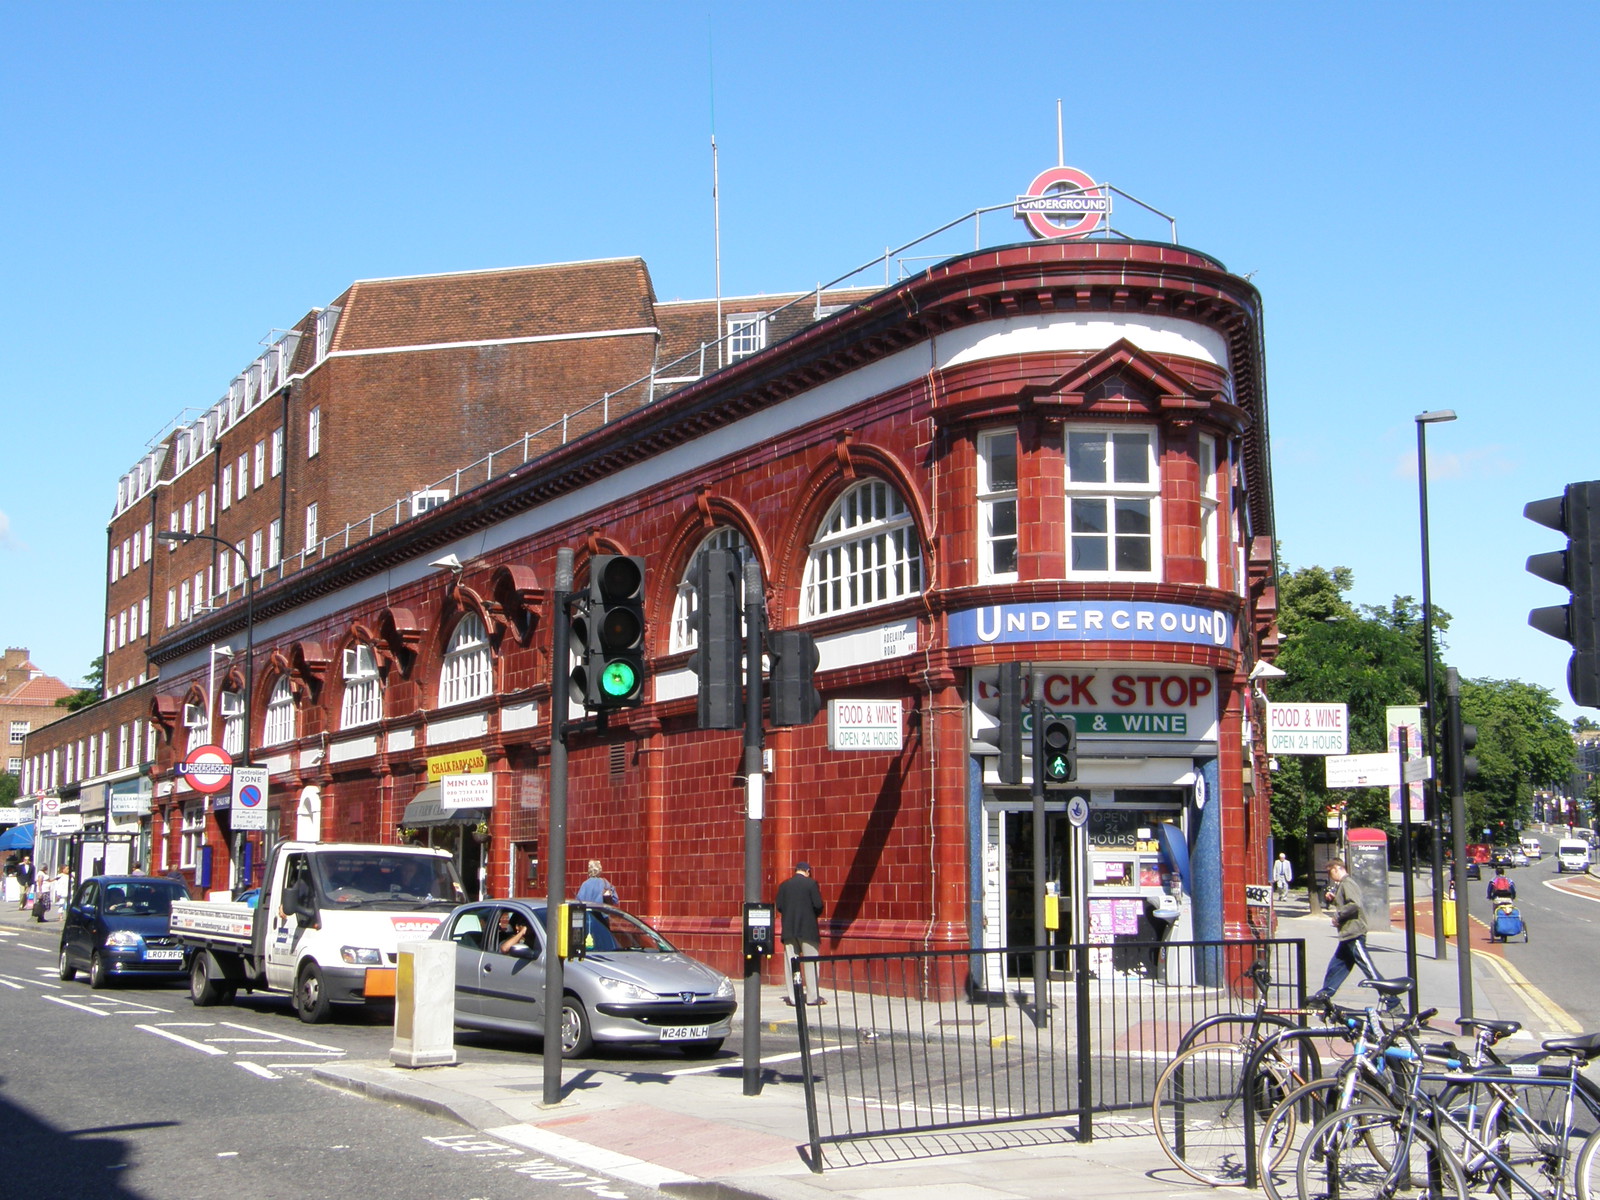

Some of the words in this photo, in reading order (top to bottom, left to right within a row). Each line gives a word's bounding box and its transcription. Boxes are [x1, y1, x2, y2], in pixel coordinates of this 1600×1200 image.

[1021, 199, 1106, 210] UNDERGROUND
[976, 605, 1227, 645] UNDERGROUND
[884, 645, 897, 656] ROAD
[1111, 675, 1212, 707] STOP
[839, 705, 863, 724] FOOD
[866, 705, 872, 723] &
[876, 705, 897, 723] WINE
[1272, 708, 1300, 727] FOOD
[1304, 708, 1311, 727] &
[1316, 708, 1341, 727] WINE
[1092, 715, 1108, 731] &
[1122, 715, 1185, 732] WINE
[839, 732, 859, 746] OPEN
[861, 732, 870, 745] 24
[873, 731, 899, 746] HOURS
[1272, 735, 1295, 749] OPEN
[1298, 735, 1309, 749] 24
[1312, 735, 1343, 750] HOURS
[431, 761, 452, 774] CHALK
[452, 758, 468, 771] FARM
[1093, 812, 1128, 823] OPEN
[1104, 823, 1118, 834] 24
[1088, 834, 1135, 845] HOURS
[147, 951, 167, 959] LR07
[661, 1028, 688, 1038] W246
[689, 1027, 709, 1037] NLH
